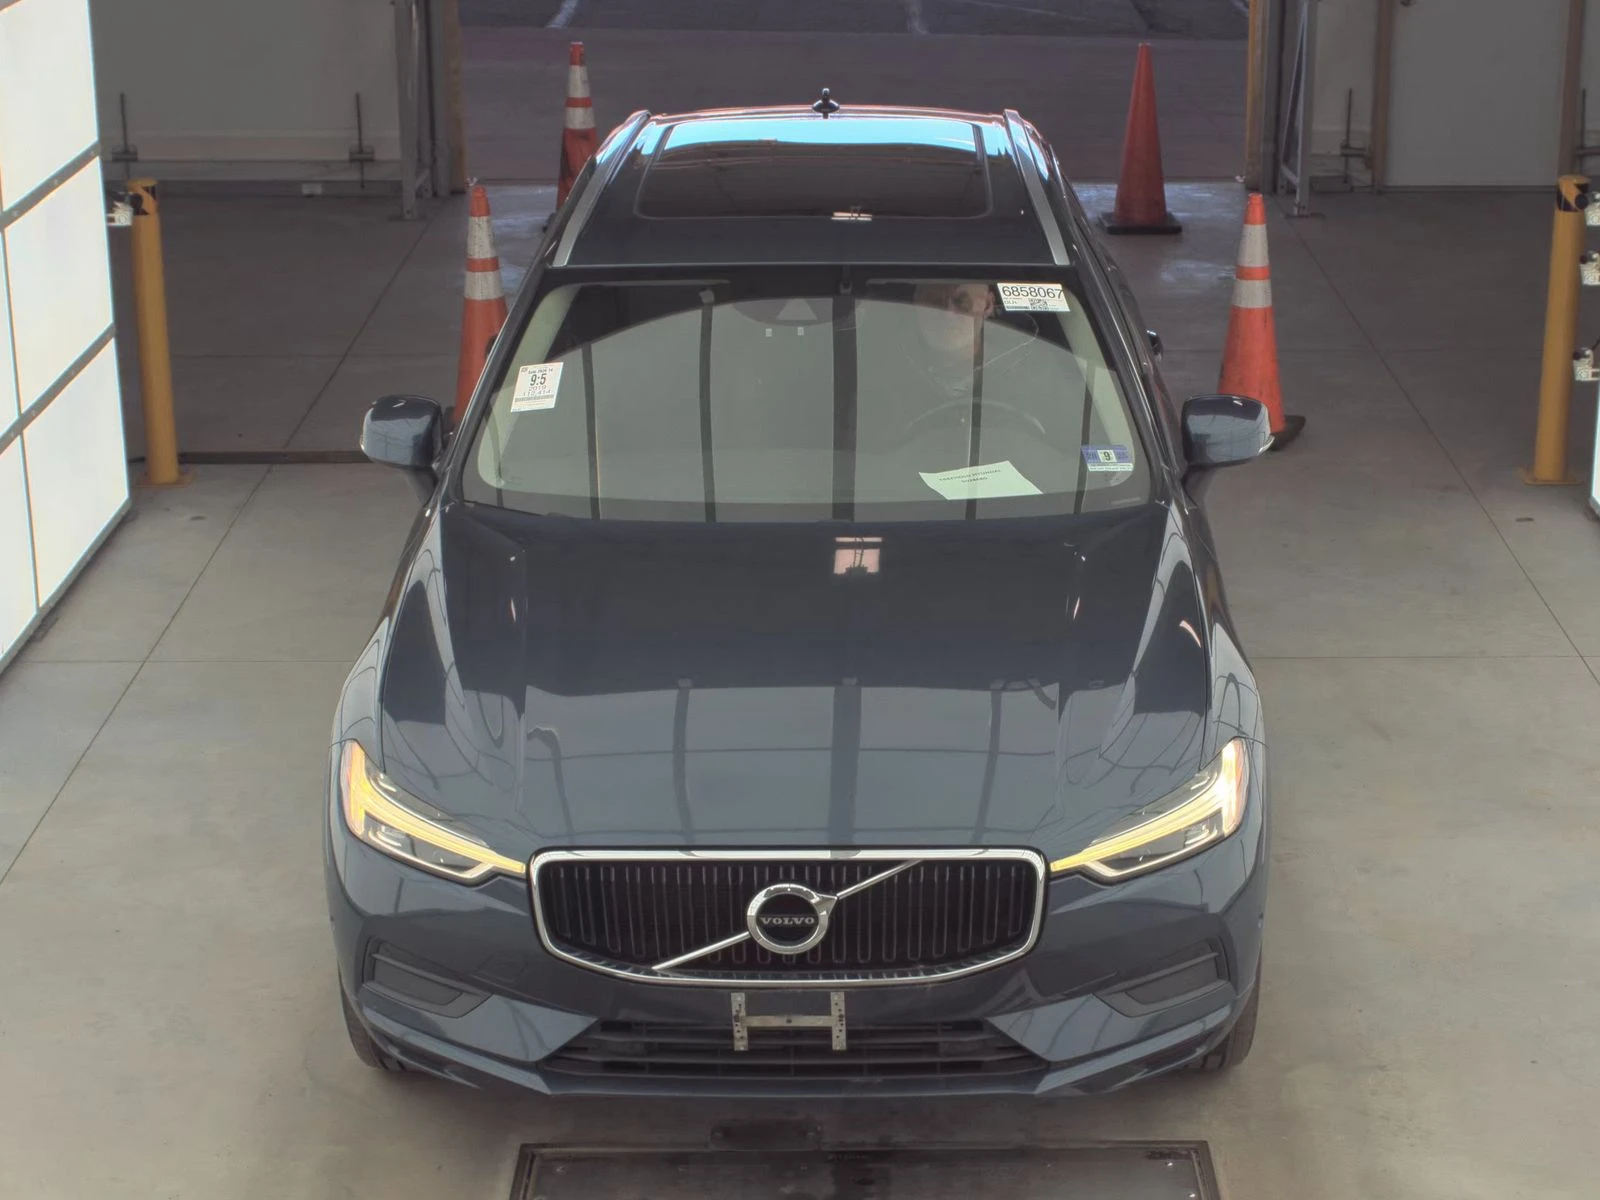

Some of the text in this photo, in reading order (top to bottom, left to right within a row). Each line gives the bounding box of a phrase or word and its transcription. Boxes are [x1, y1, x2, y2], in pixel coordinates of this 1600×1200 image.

[1002, 285, 1064, 299] 6858067
[530, 373, 547, 386] 9:5
[1103, 451, 1110, 461] 9
[761, 917, 815, 925] VOLVO
